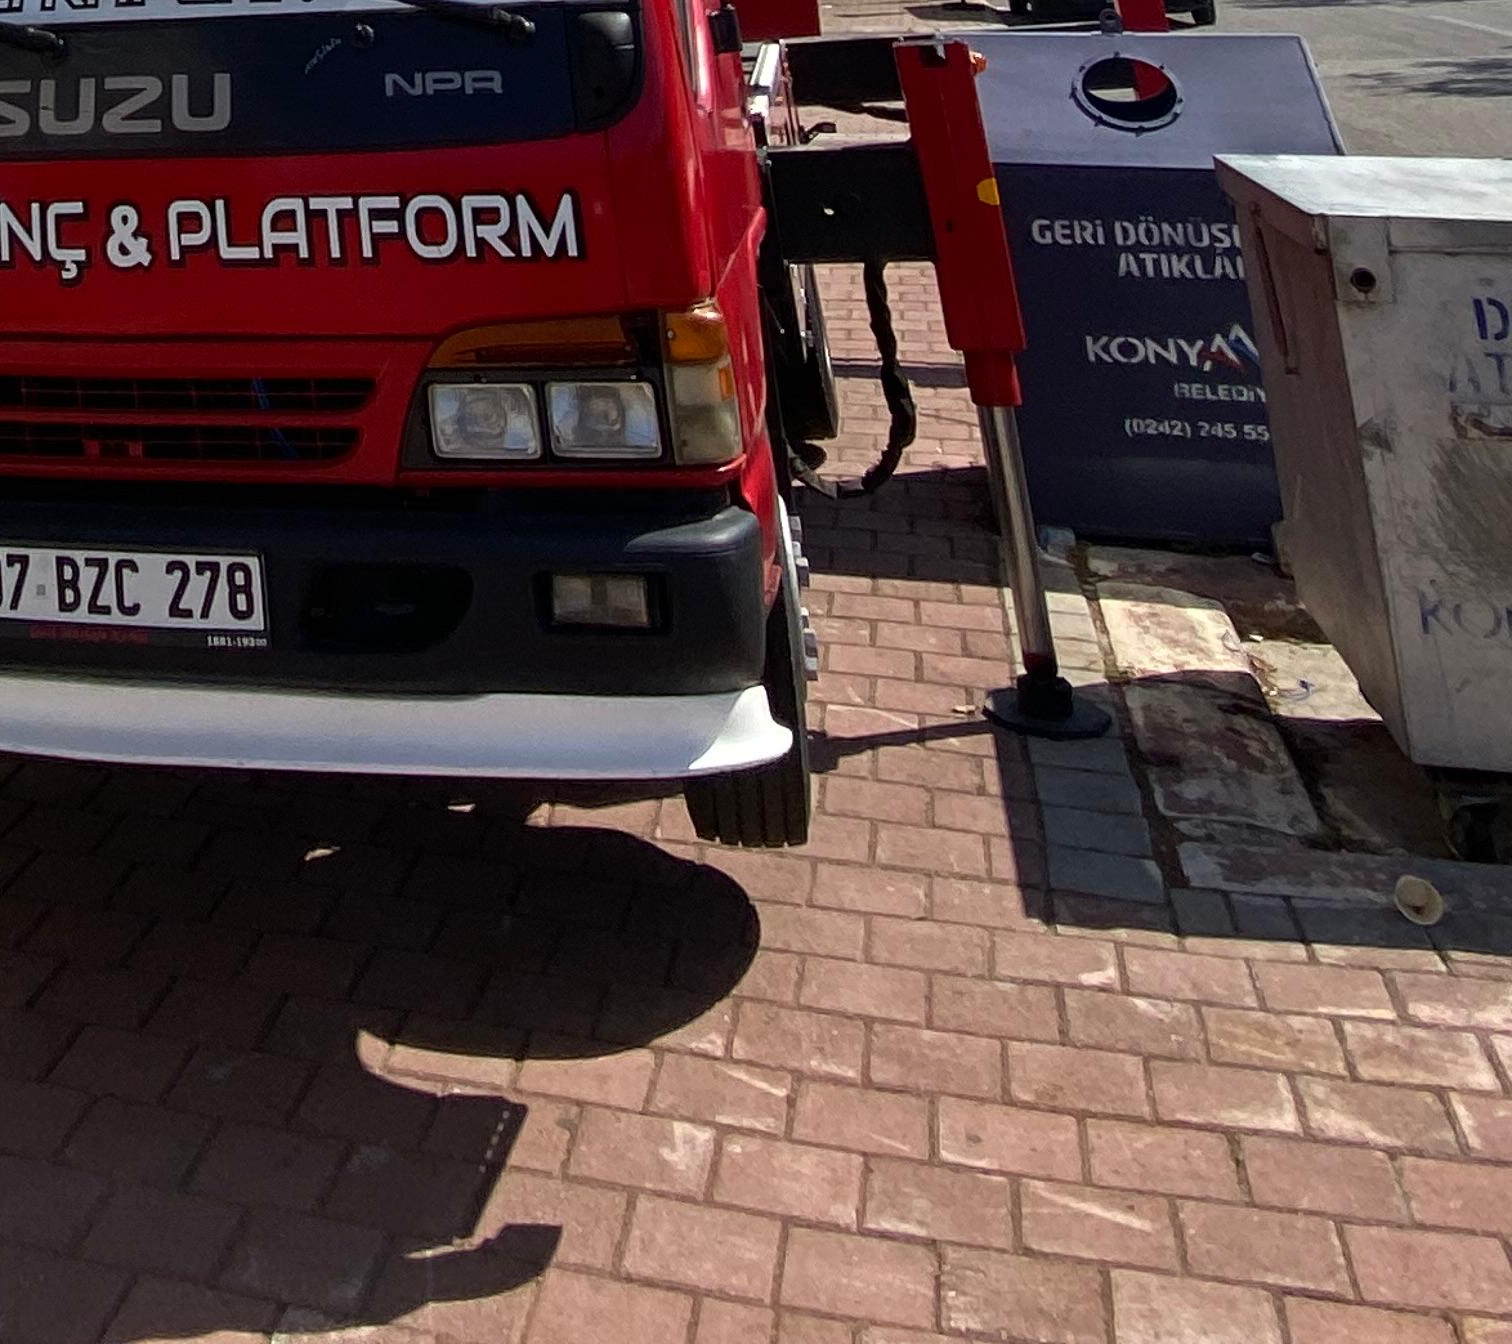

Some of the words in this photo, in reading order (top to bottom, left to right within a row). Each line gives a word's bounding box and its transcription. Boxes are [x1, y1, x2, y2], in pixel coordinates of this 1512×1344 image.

[384, 69, 504, 97] NPR
[106, 205, 153, 267] &
[168, 192, 581, 263] PLATFORM
[55, 555, 141, 617] BZC
[165, 559, 255, 621] 278
